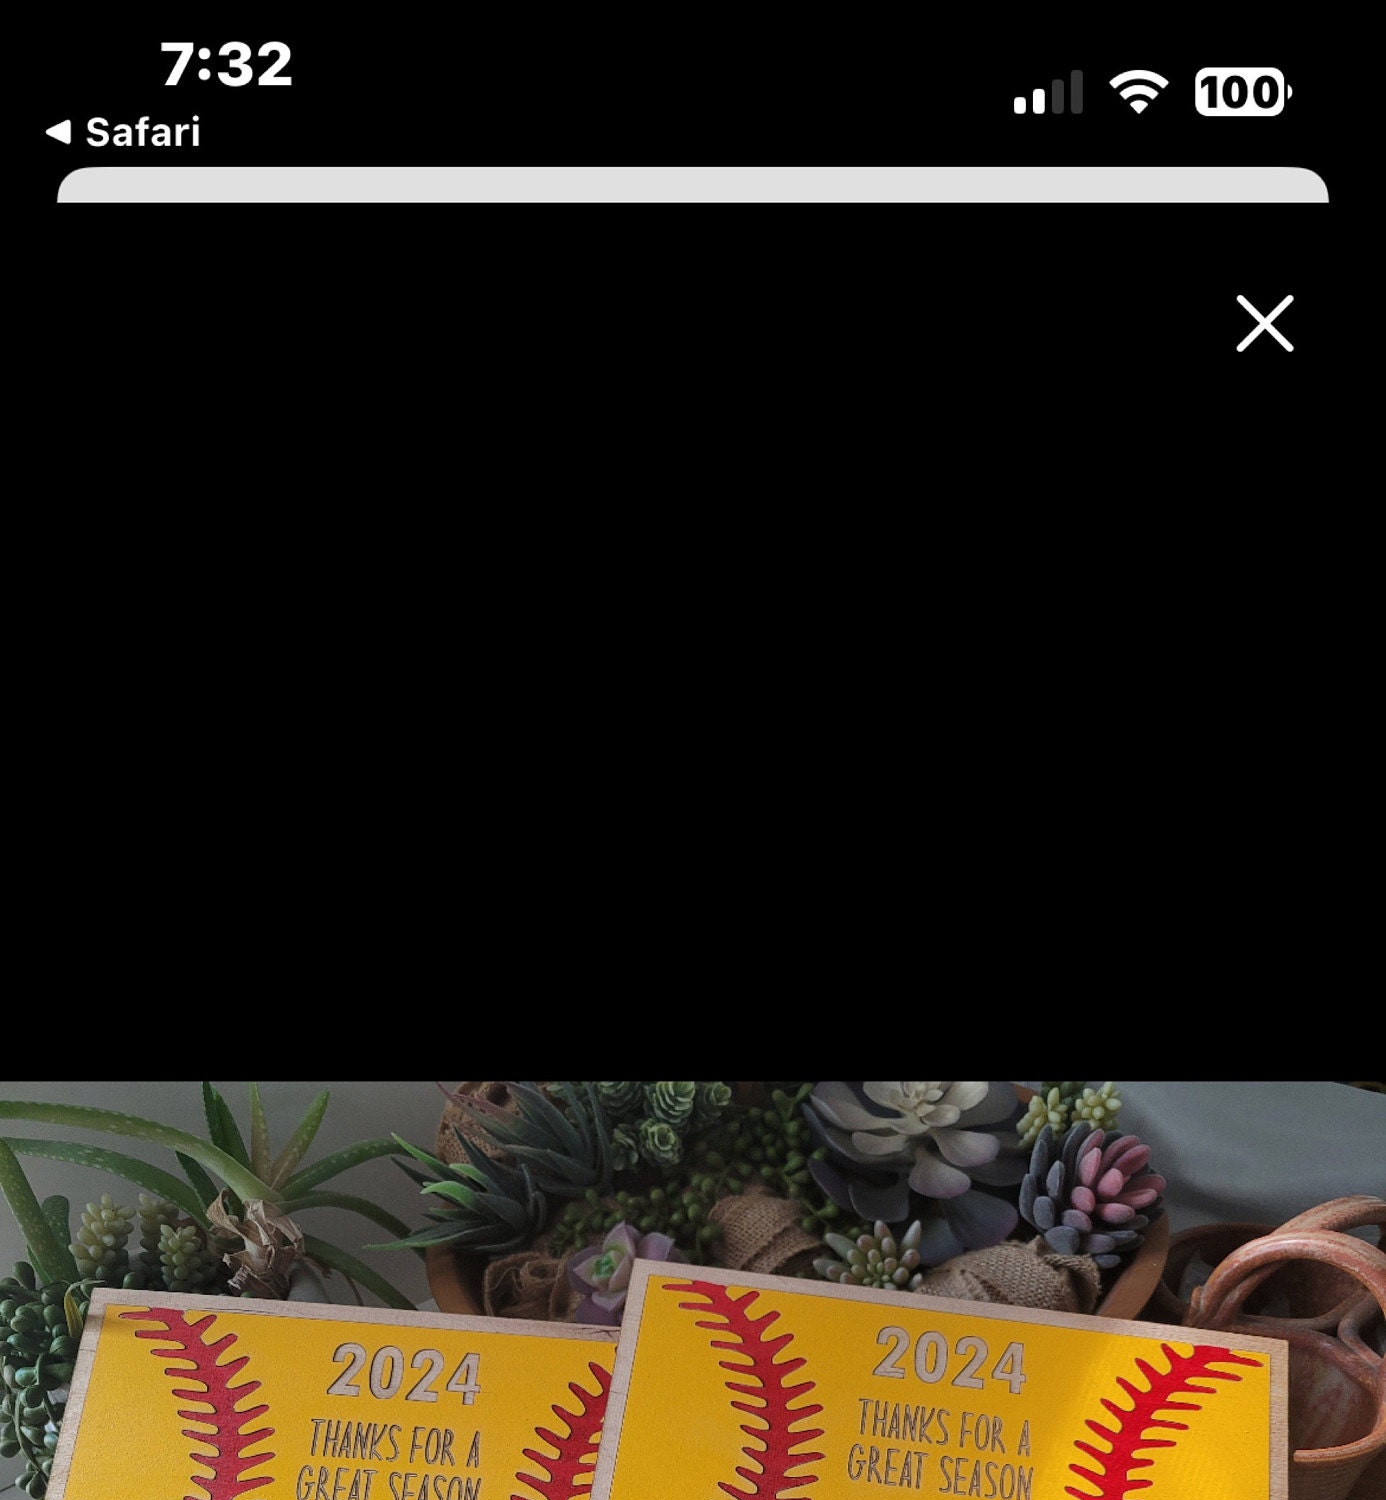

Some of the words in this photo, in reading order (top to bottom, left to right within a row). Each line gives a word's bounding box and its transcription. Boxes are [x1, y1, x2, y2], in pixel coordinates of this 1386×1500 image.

[327, 1342, 481, 1405] 2024
[873, 1326, 1026, 1394] 2024
[311, 1419, 401, 1462] THANKS
[410, 1427, 455, 1466] FOR
[466, 1431, 480, 1468] A
[859, 1399, 950, 1445] THANKS
[960, 1412, 1005, 1454] FOR
[1018, 1420, 1030, 1456] A
[848, 1444, 928, 1489] GREAT
